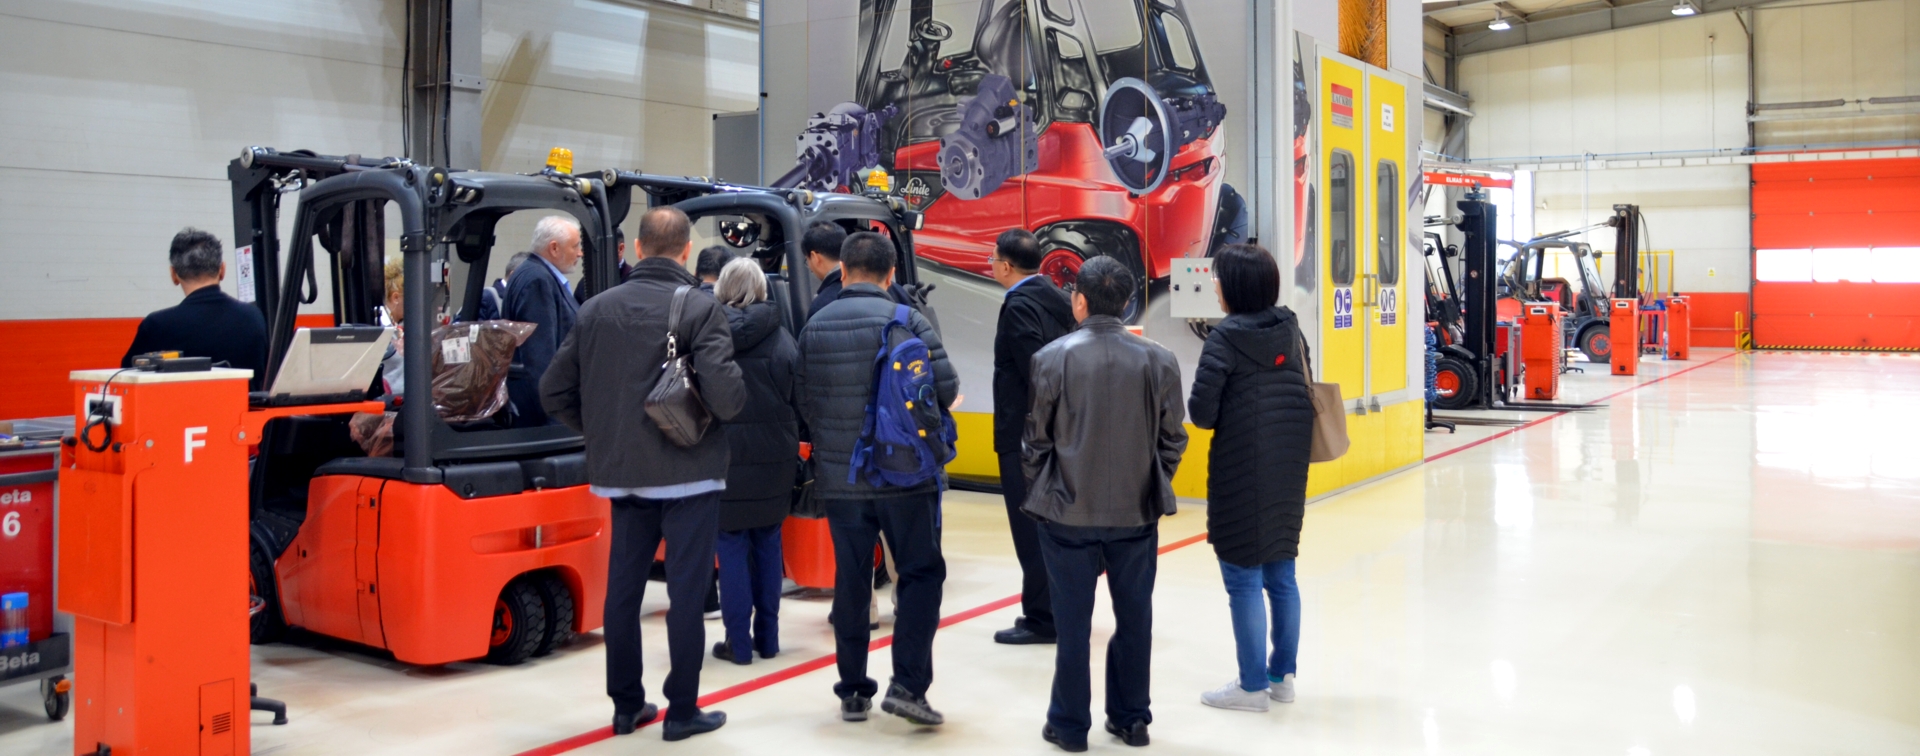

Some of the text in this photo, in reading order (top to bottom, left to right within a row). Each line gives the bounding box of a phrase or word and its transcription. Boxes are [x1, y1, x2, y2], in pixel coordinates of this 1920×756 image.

[900, 177, 930, 196] Linde
[185, 426, 208, 463] F
[0, 489, 32, 504] eta
[2, 511, 21, 536] 6
